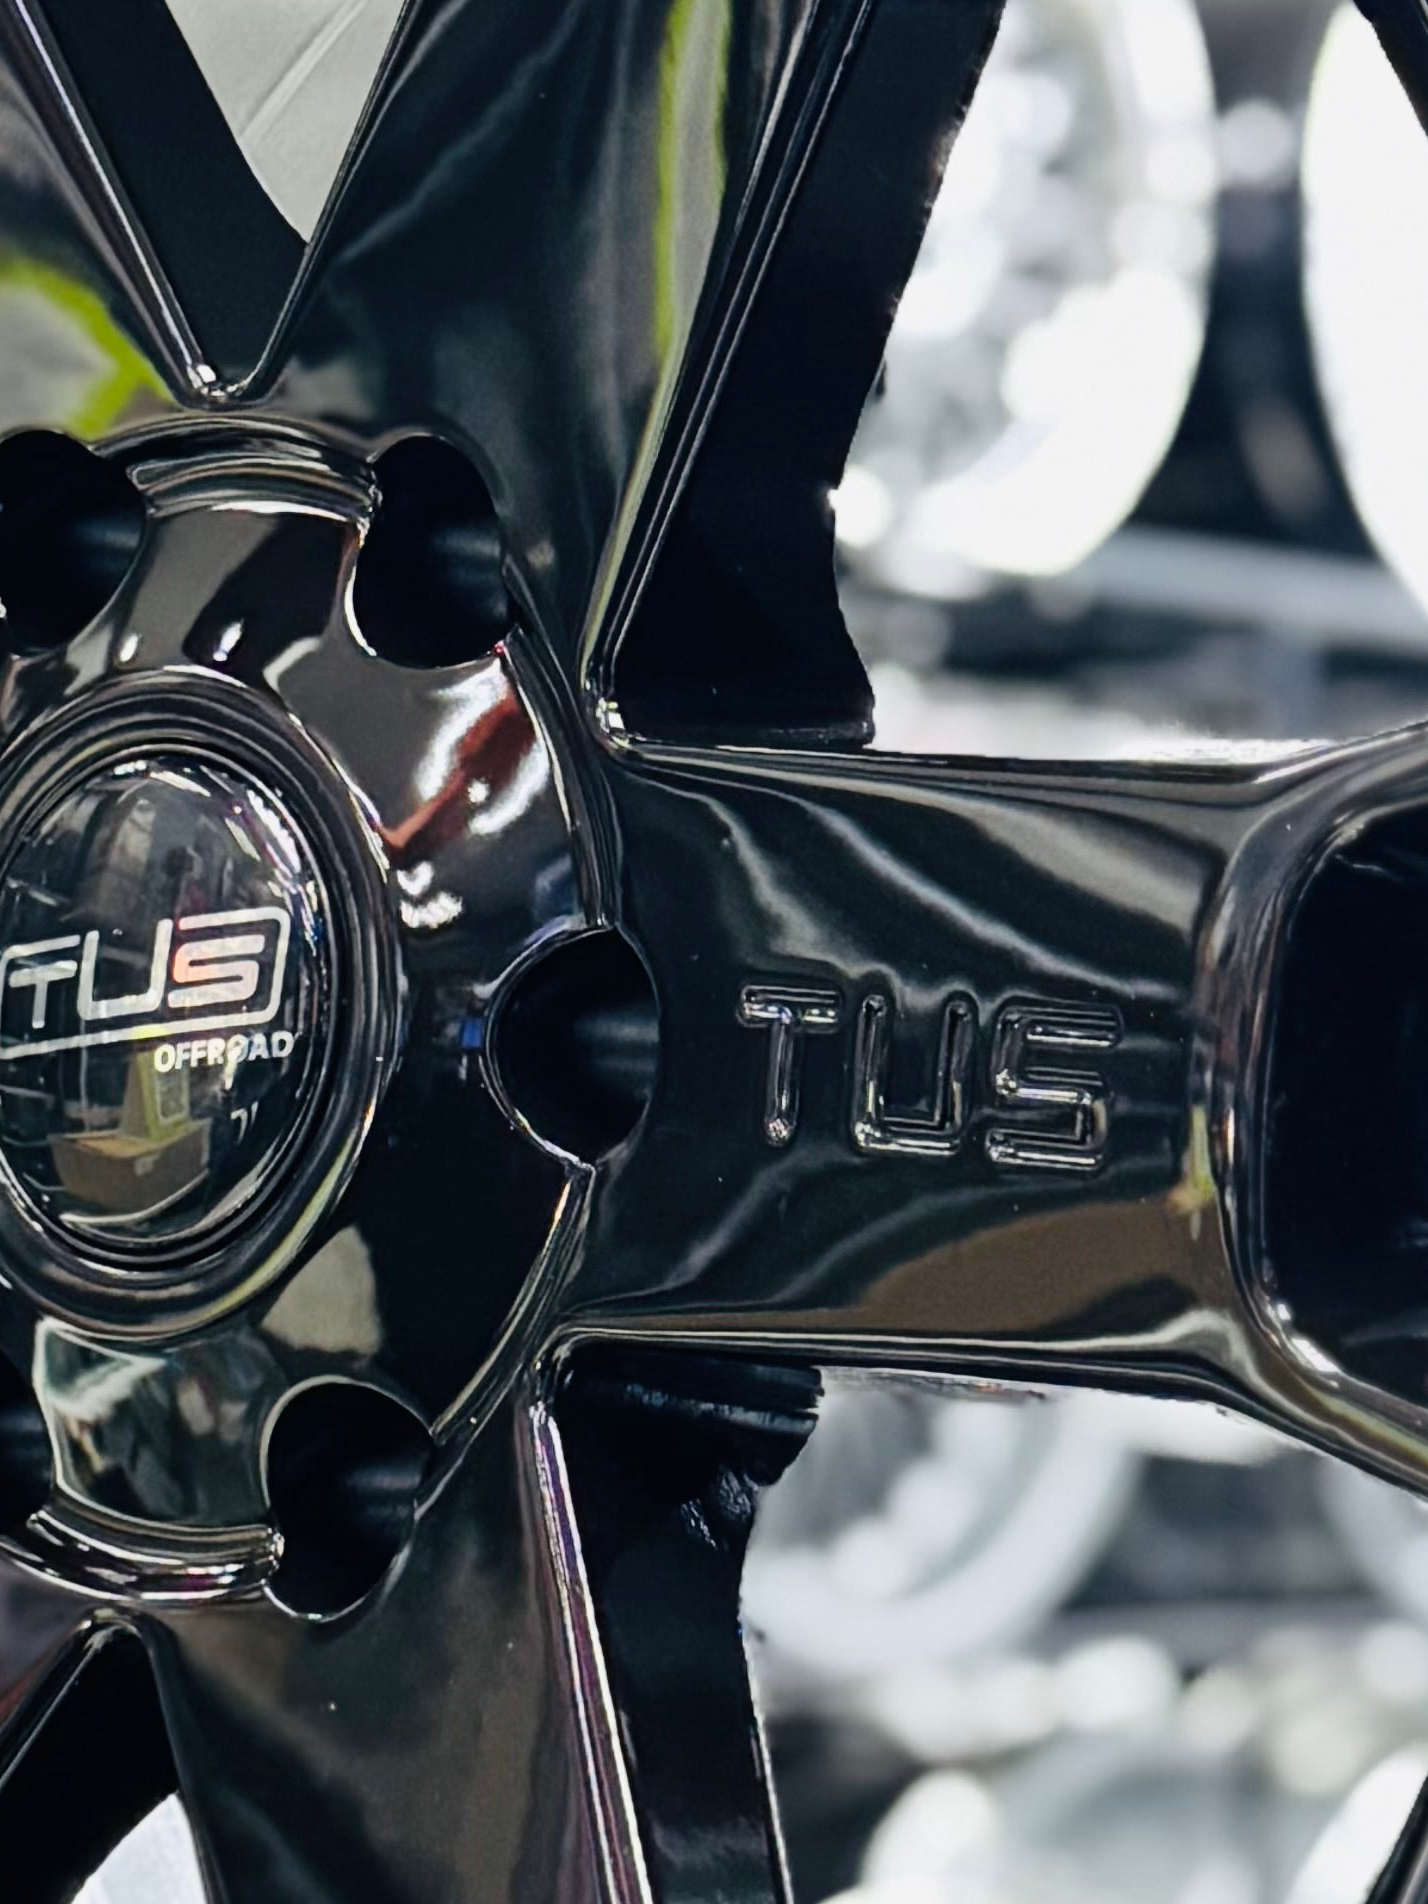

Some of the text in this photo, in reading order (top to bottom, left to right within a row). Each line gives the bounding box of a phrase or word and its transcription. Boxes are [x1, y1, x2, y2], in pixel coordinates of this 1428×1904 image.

[5, 916, 268, 1031] TUS
[153, 1028, 295, 1074] OFFROAD
[736, 982, 1124, 1176] TUS
